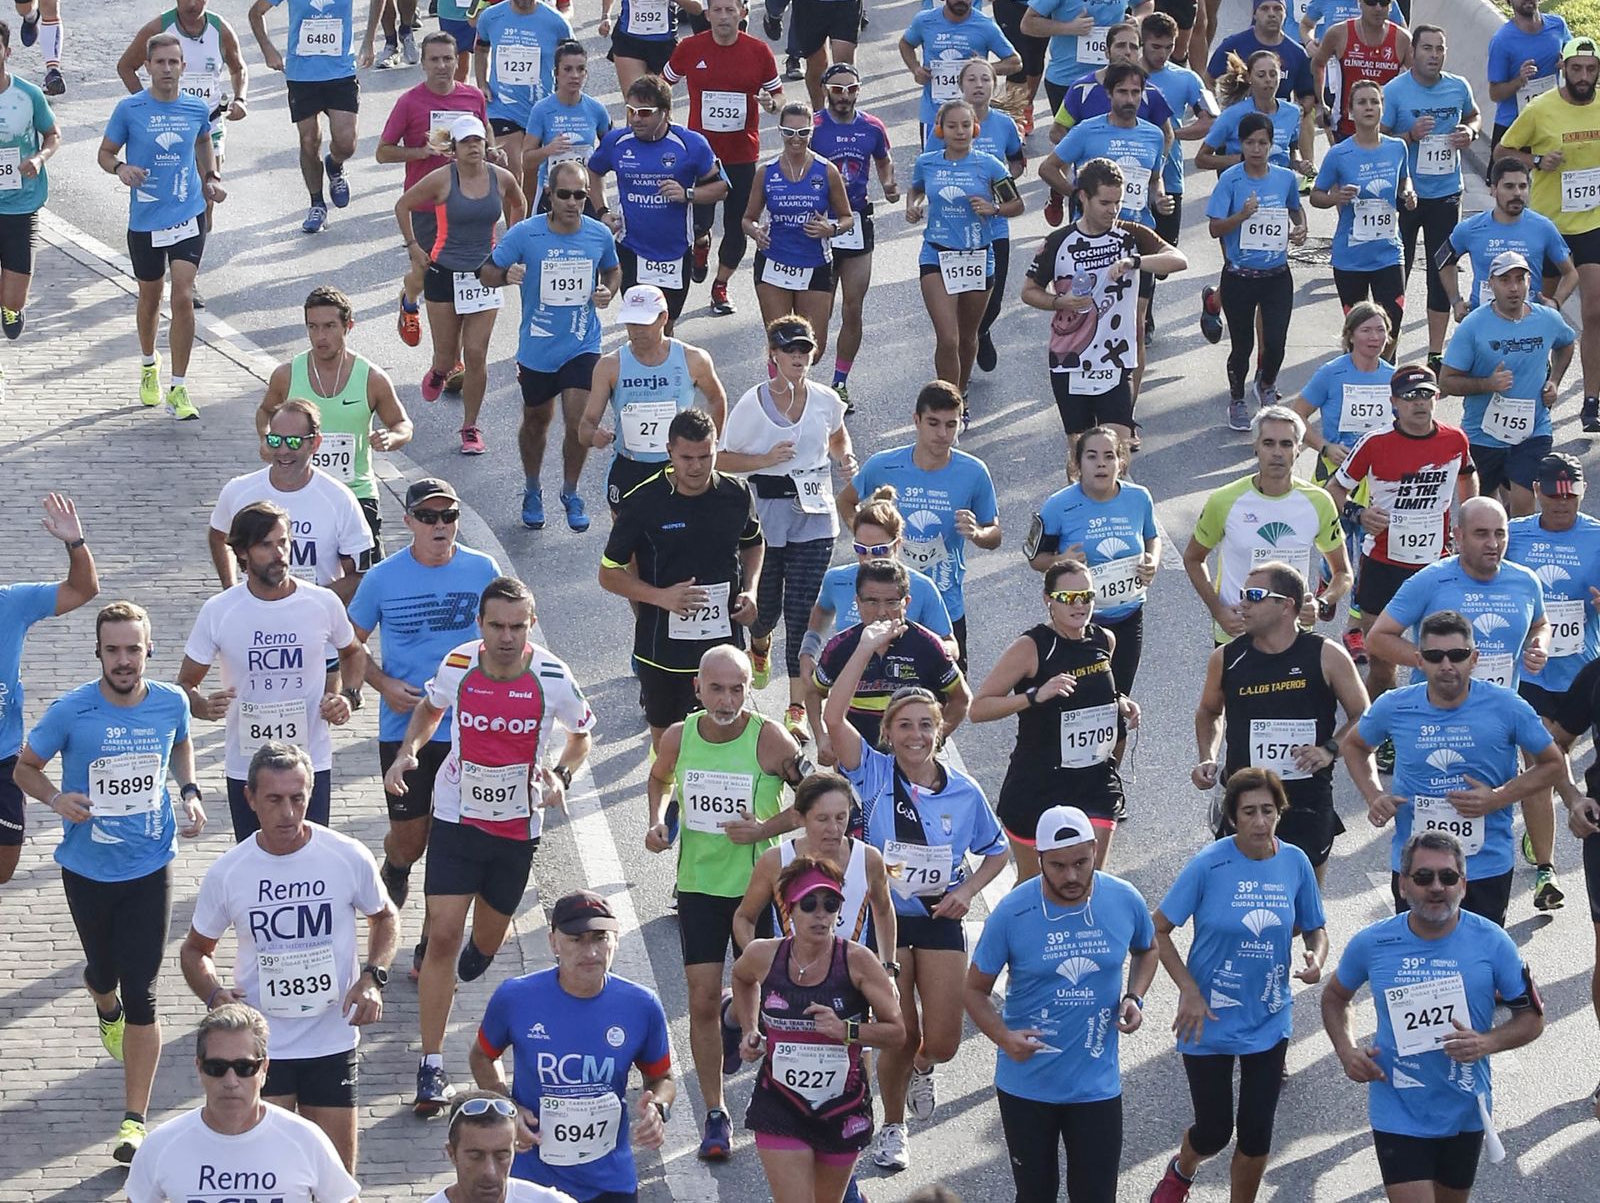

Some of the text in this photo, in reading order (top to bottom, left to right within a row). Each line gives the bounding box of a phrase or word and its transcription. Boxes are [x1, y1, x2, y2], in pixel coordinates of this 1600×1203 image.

[635, 11, 662, 23] 8592
[306, 33, 336, 45] 6480
[504, 60, 533, 72] 1237
[709, 106, 740, 120] 2532
[1426, 149, 1451, 163] 1159
[1362, 214, 1391, 227] 1158
[1249, 223, 1282, 237] 6162
[645, 259, 677, 275] 6482
[773, 259, 804, 278] 6481
[945, 264, 983, 280] 15156
[550, 277, 584, 292] 1931
[622, 374, 669, 391] nerja
[1350, 403, 1383, 417] 8573
[639, 421, 658, 436] 27
[1493, 412, 1528, 430] 1155
[312, 452, 350, 467] 5970
[1400, 471, 1448, 485] WHERE
[1397, 484, 1440, 496] IS THE
[1393, 496, 1437, 510] LIMIT?
[1398, 533, 1435, 548] 1927
[1100, 576, 1143, 599] 18379
[1544, 592, 1569, 602] nicaja
[252, 630, 297, 646] Remo
[248, 648, 303, 672] RCM
[1271, 679, 1306, 692] TAPEROS
[509, 690, 534, 699] David
[250, 722, 297, 739] 8413
[460, 712, 538, 734] DCOOP
[104, 737, 160, 746] CARRERA URBANA
[1067, 726, 1115, 749] 15709
[1256, 743, 1310, 760] 157
[96, 774, 154, 797] 15899
[472, 785, 517, 804] 6897
[689, 793, 748, 814] 18635
[259, 879, 326, 903] Remo
[1234, 893, 1288, 901] CARRERA URBANA
[1232, 900, 1254, 909] CIUDAD
[248, 902, 334, 943] RCM
[1044, 941, 1108, 954] CARRERA URBANA
[1240, 940, 1275, 952] Unicaja
[1042, 951, 1069, 961] CIUDAD
[1069, 949, 1082, 958] DE
[266, 972, 334, 1000] 13839
[1057, 987, 1095, 999] Unicaja
[1404, 1004, 1456, 1031] 2427
[1084, 1016, 1095, 1050] Renault
[537, 1052, 616, 1086] RCM
[785, 1068, 838, 1090] 6227
[555, 1120, 609, 1144] 6947
[198, 1164, 278, 1191] Remo
